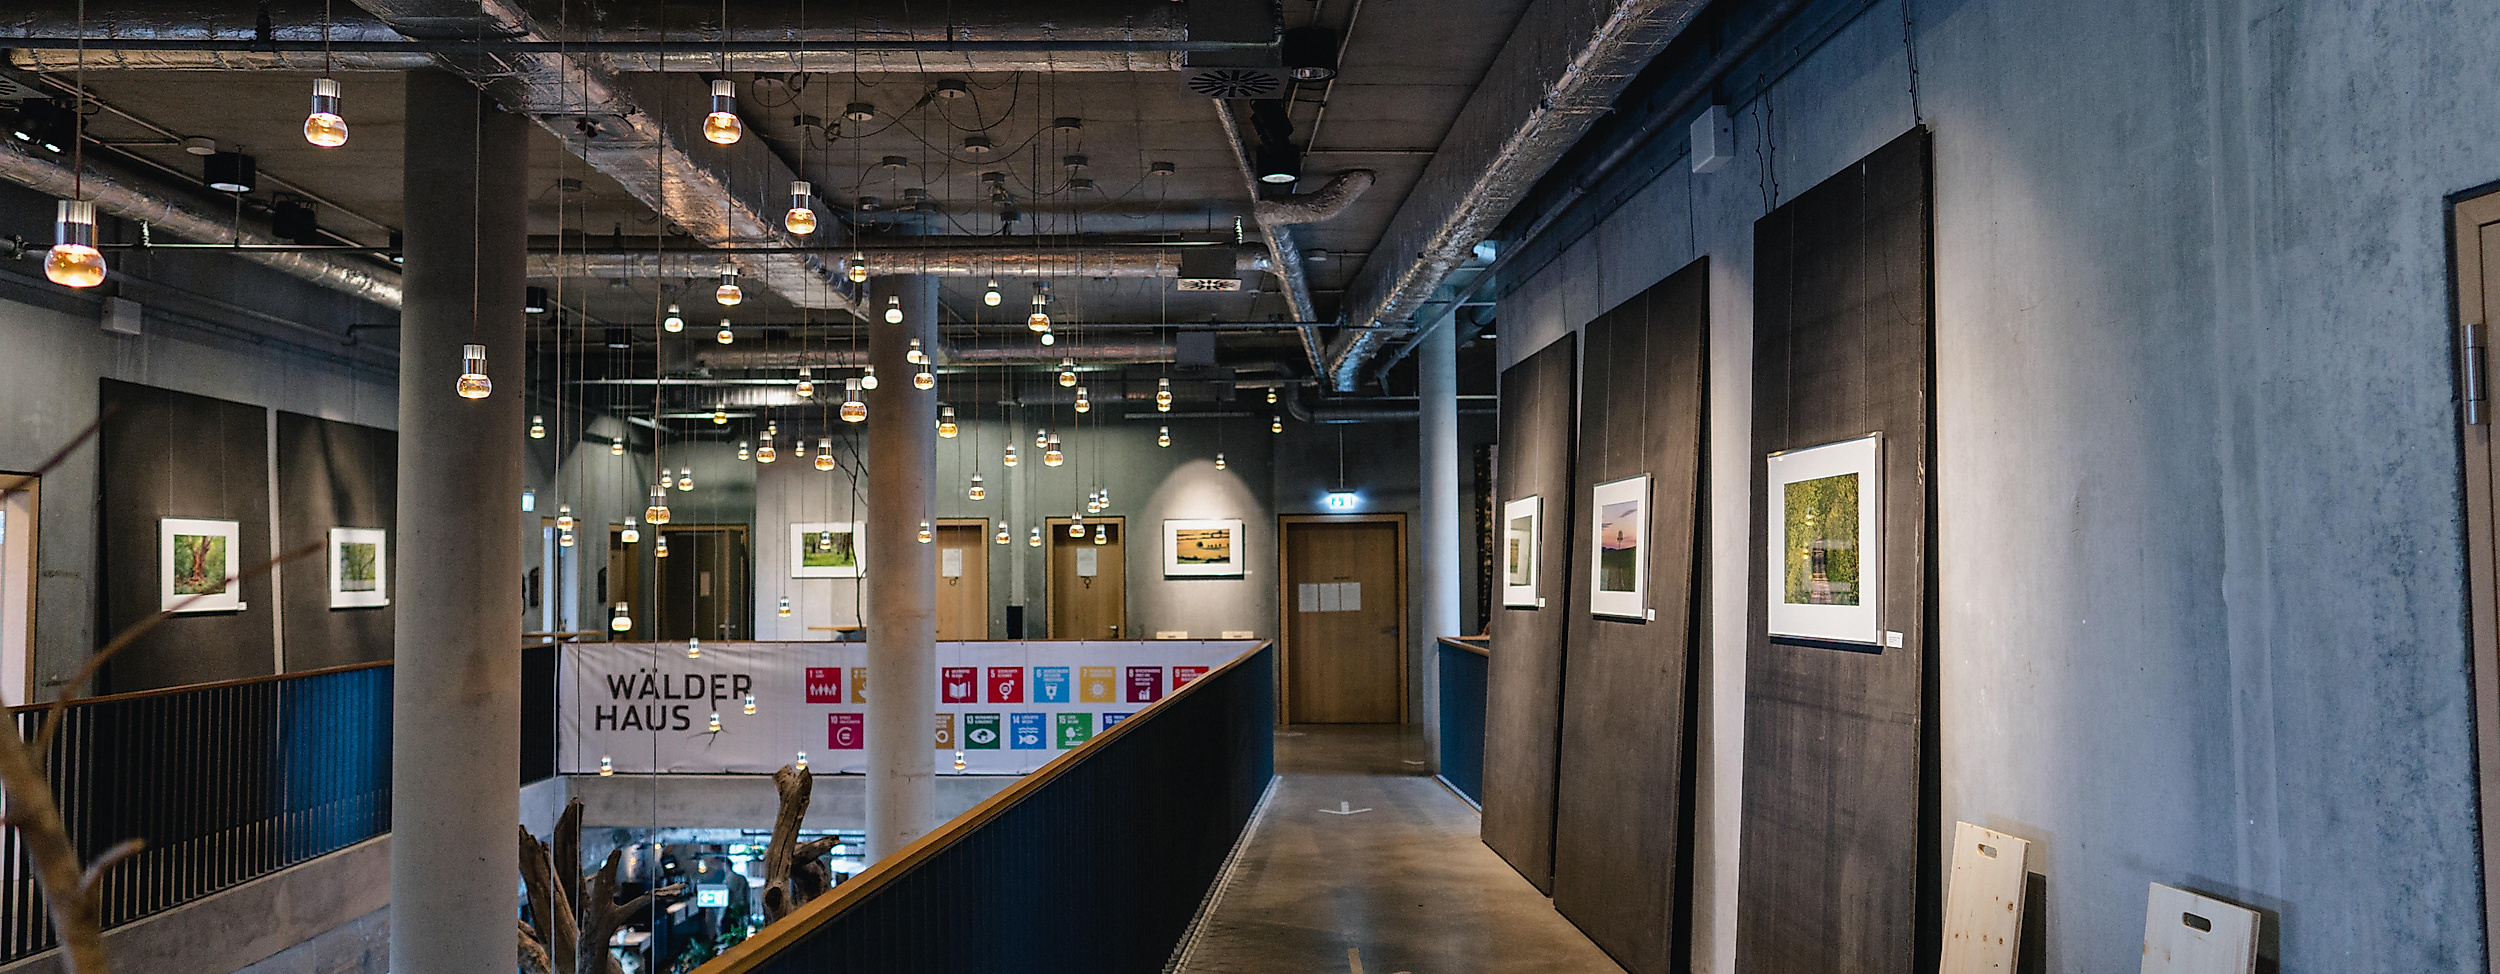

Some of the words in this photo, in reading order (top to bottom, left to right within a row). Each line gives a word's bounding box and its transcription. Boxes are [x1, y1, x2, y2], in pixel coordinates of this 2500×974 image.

[606, 668, 752, 701] WÄLDER
[594, 705, 691, 731] HAUS
[830, 715, 838, 724] 10
[966, 715, 974, 724] 13
[1012, 715, 1020, 724] 14
[1058, 715, 1066, 724] 15
